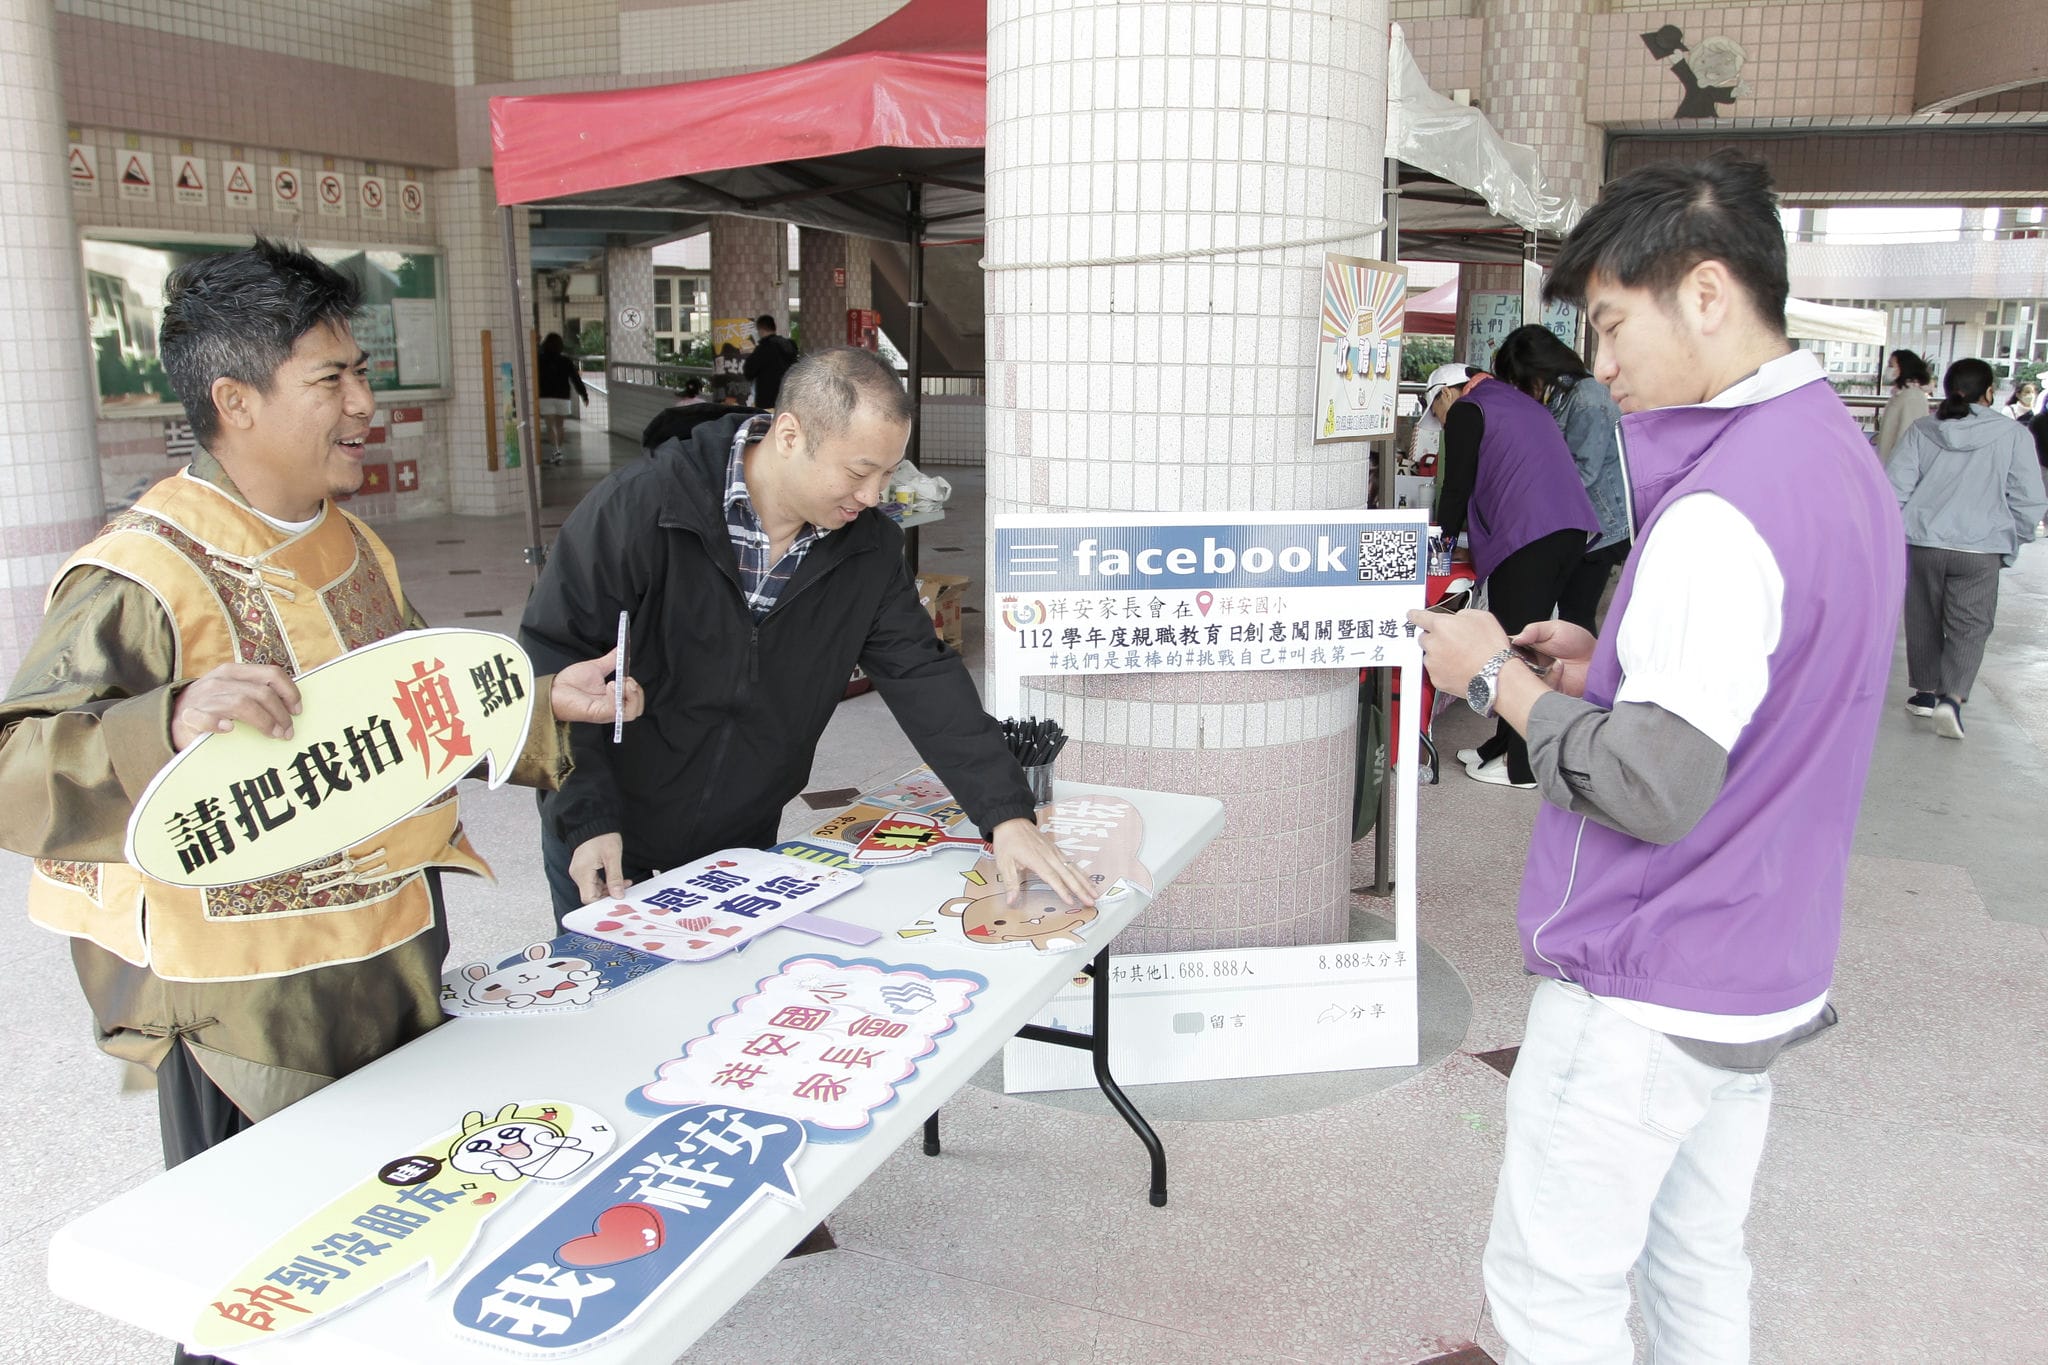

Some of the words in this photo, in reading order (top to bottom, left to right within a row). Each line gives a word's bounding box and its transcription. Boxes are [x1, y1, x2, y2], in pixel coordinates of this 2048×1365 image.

[1073, 537, 1347, 576] facebook
[1219, 597, 1287, 615] 祥安國小
[164, 653, 525, 875] 請把我拍瘦點
[641, 870, 750, 913] 感謝
[713, 876, 820, 918] 有您
[711, 983, 848, 1092] 祥安國小
[1209, 1013, 1247, 1030] 留言
[1349, 1003, 1386, 1020] 分享
[793, 1015, 908, 1103] 家長會
[476, 1262, 616, 1338] 我
[614, 1108, 788, 1215] 祥安
[210, 1182, 468, 1332] 帥到沒朋友
